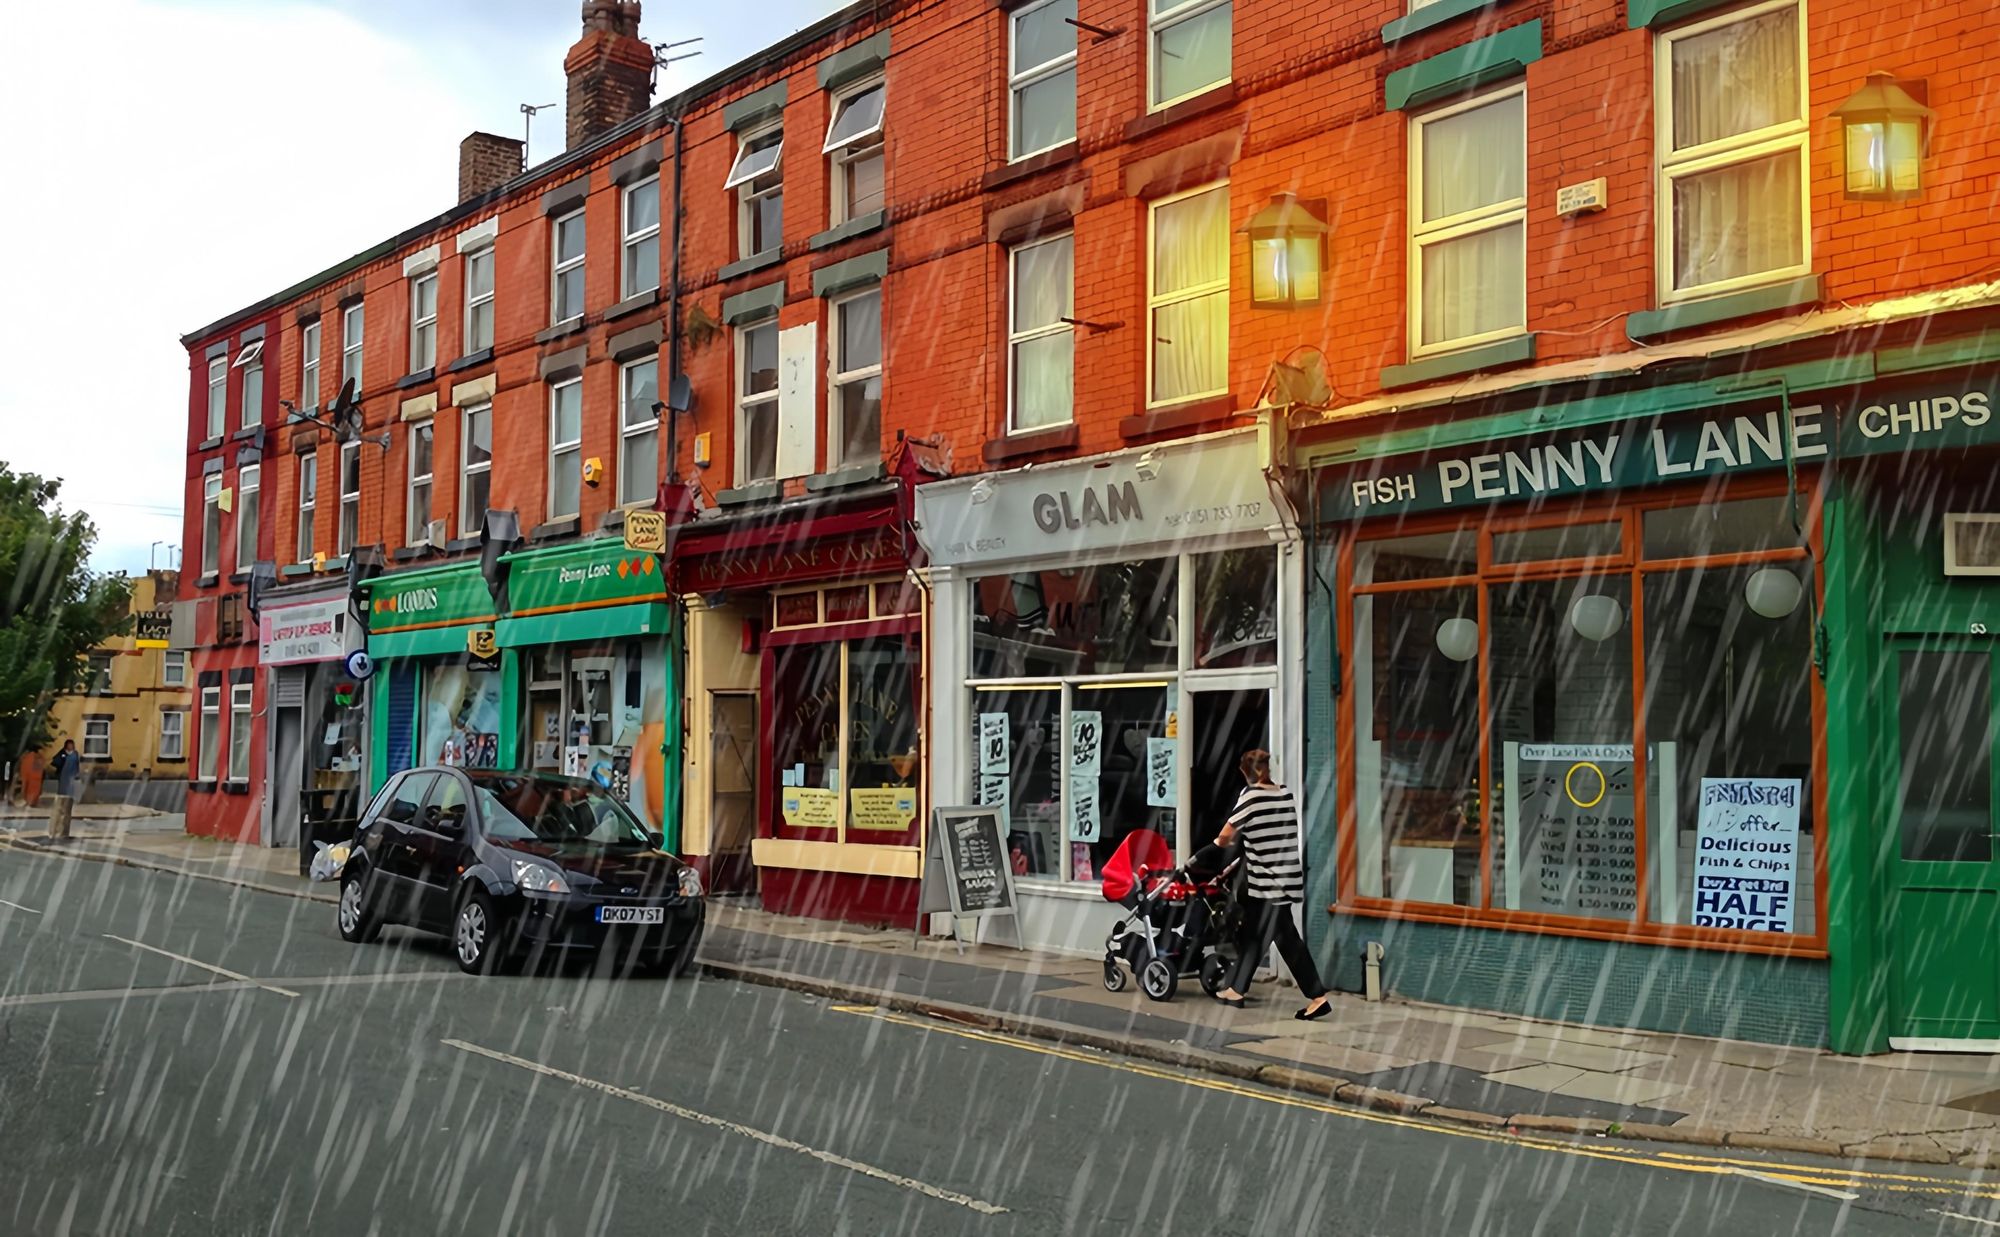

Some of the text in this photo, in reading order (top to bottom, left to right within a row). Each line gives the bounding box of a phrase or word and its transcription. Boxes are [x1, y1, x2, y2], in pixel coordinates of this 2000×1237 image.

[1352, 392, 1992, 507] FISH PENNY LANE CHIPS
[1032, 480, 1144, 535] GLAM
[630, 516, 660, 525] PENNY
[1701, 836, 1792, 854] Delicious
[1699, 856, 1791, 873] Fish & Chips
[1696, 891, 1789, 918] HALF
[603, 908, 636, 921] DK07
